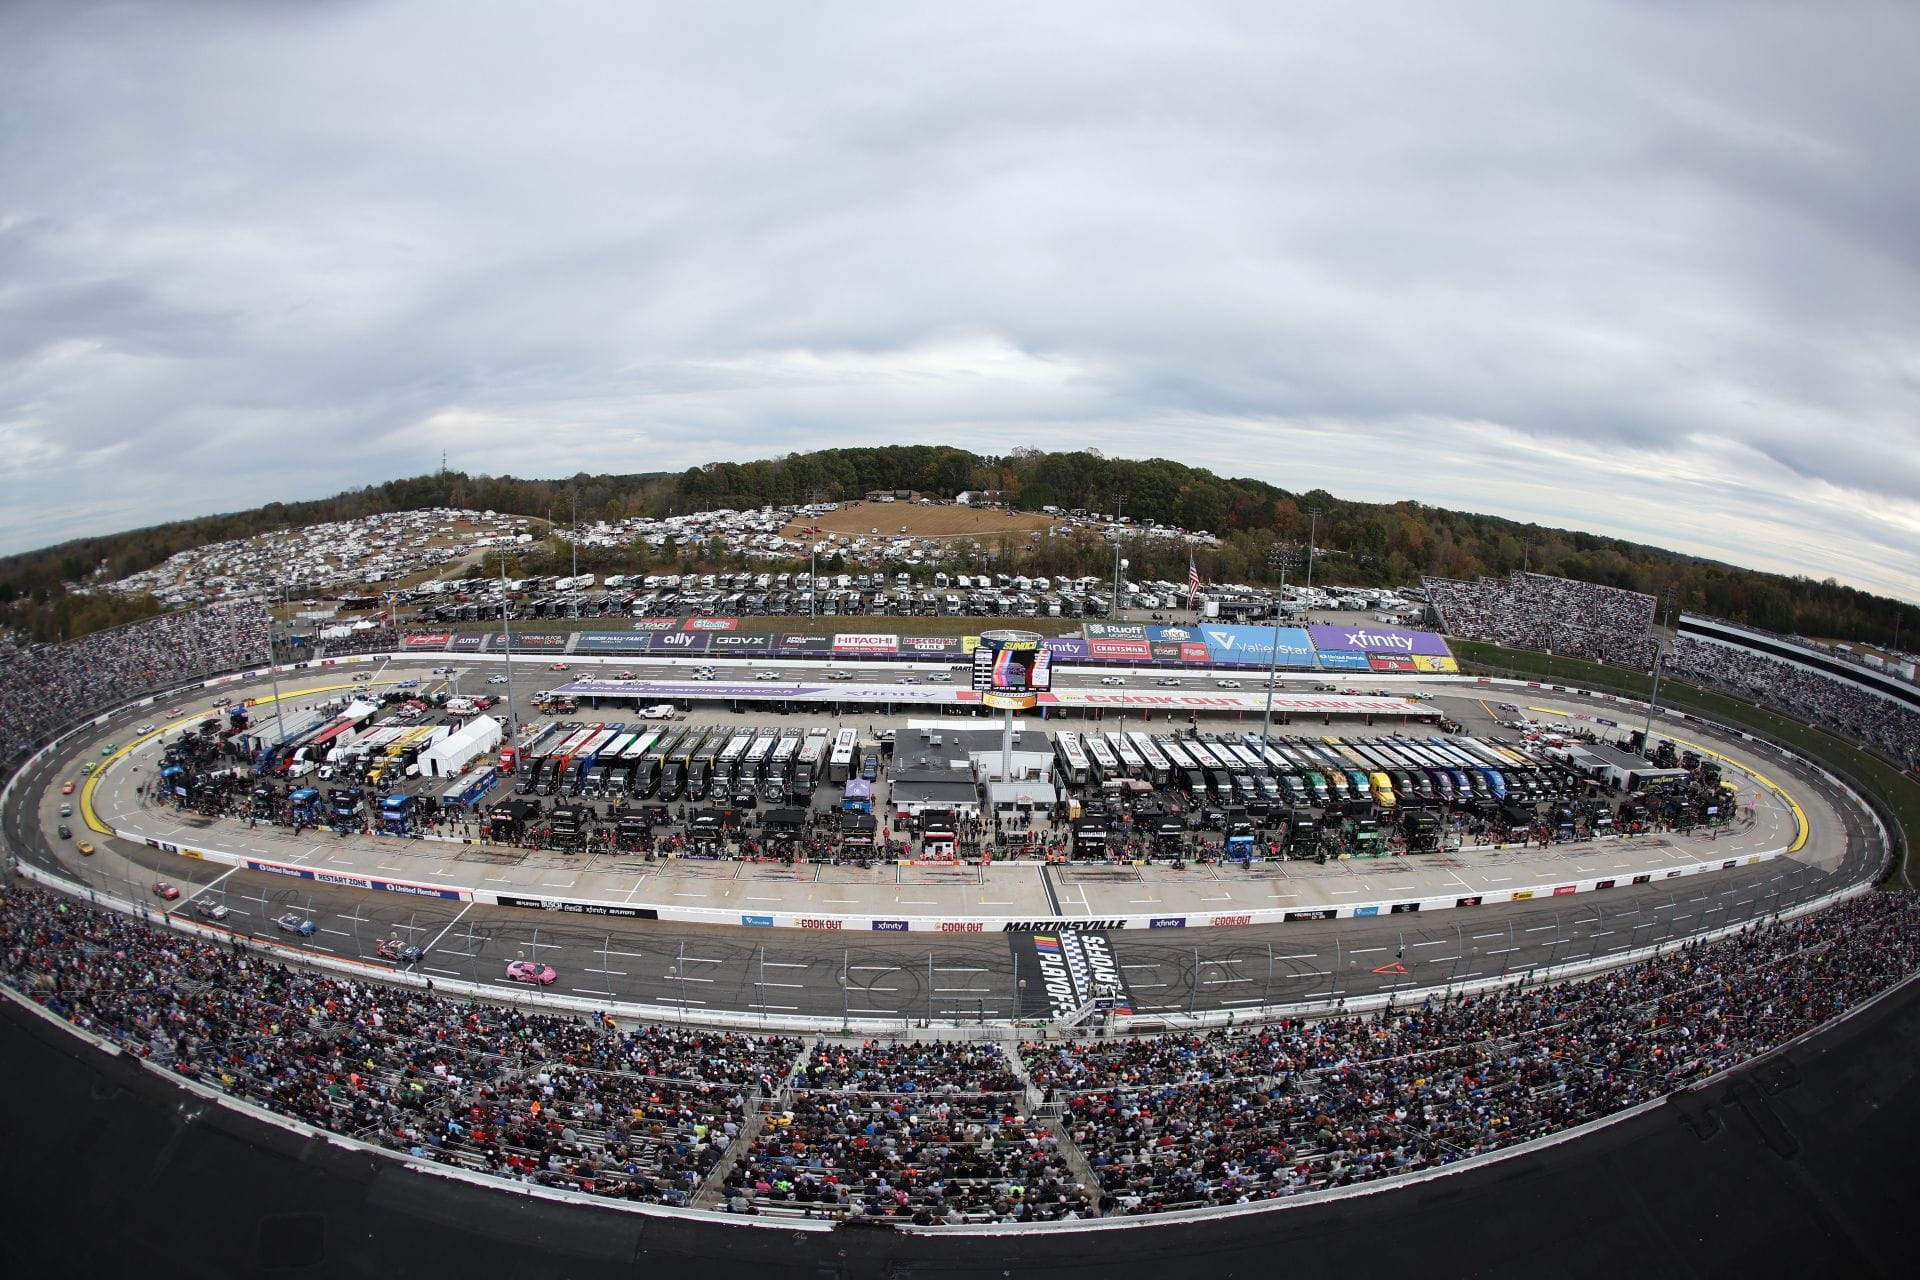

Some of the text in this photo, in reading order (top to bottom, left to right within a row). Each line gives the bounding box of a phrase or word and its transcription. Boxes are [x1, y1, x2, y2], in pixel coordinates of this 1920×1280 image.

[1107, 626, 1143, 634] Ruoff
[663, 633, 695, 646] ally
[1345, 631, 1413, 650] xfinity
[1003, 641, 1037, 650] SUNOCO
[1085, 695, 1244, 706] COOK OUT
[1273, 699, 1411, 710] COOK OUT
[266, 866, 301, 877] United Rentals
[318, 874, 368, 888] RESTART ZONE
[395, 886, 440, 897] United Rentals
[585, 906, 607, 914] xfinity
[801, 919, 842, 929] COOK OUT
[878, 922, 903, 930] xfinity
[1002, 920, 1128, 932] MARTINSVILLE
[1156, 920, 1179, 929] xfinity
[1214, 915, 1252, 926] COOK OUT
[942, 923, 984, 932] COOK OUT
